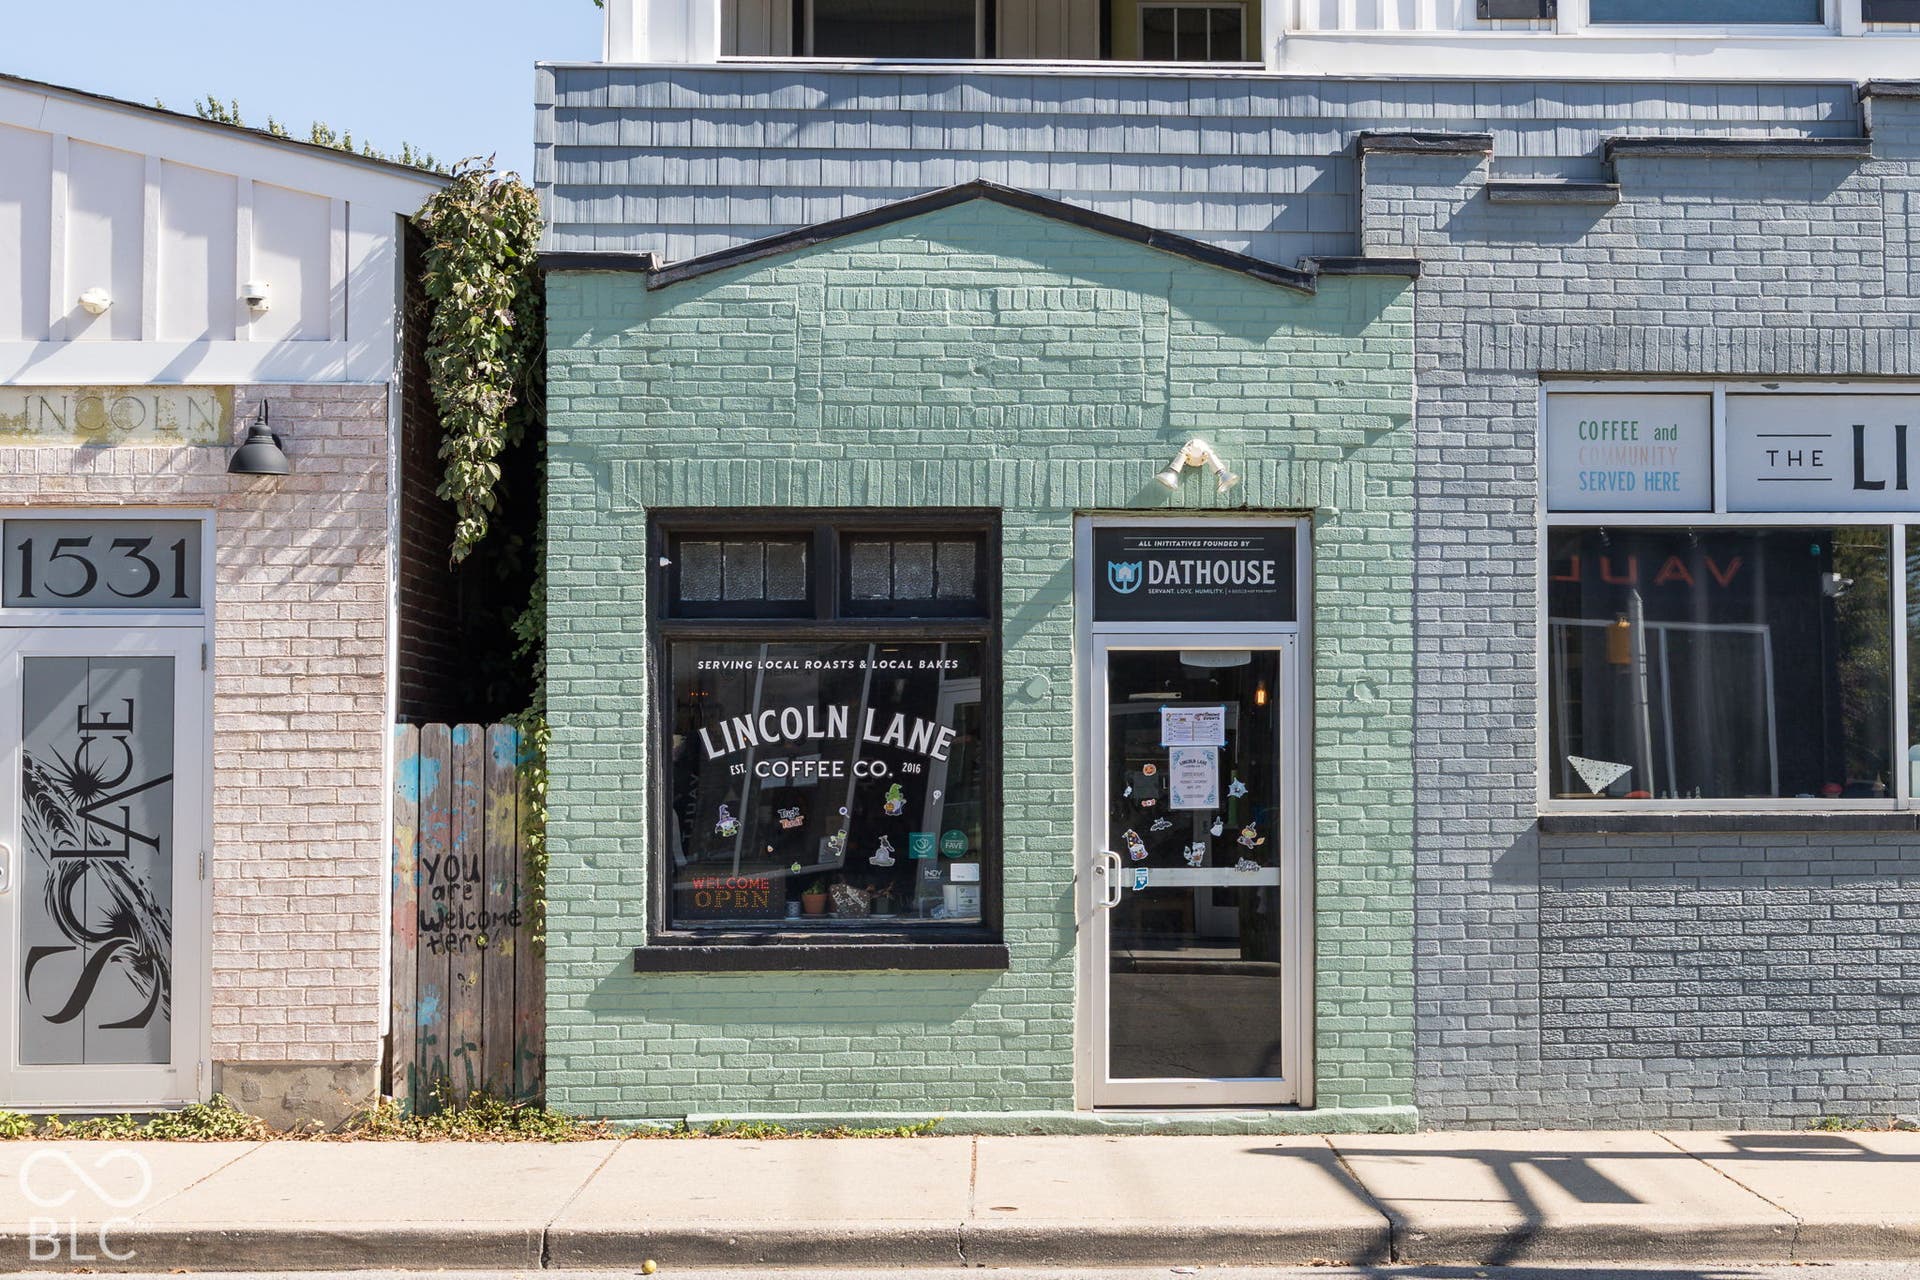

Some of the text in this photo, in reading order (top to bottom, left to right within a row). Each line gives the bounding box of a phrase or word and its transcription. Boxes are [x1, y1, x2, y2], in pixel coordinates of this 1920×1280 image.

[0, 395, 215, 431] INCOLN
[1579, 420, 1678, 441] COFFEE and
[1579, 445, 1680, 466] COMMUNITY
[1766, 424, 1909, 490] THE LI
[1579, 471, 1680, 492] SERVED HERE
[17, 535, 191, 599] 1531
[1147, 560, 1276, 585] DATHOUSE
[698, 660, 959, 670] SERVING LOCAL ROASTS & LOCAL BAKES
[699, 705, 957, 761] LINCOLN LANE
[730, 760, 921, 778] EST. COFFEE CO. 2016
[432, 883, 473, 901] are
[692, 877, 770, 889] WELCOME
[695, 891, 770, 908] OPEN
